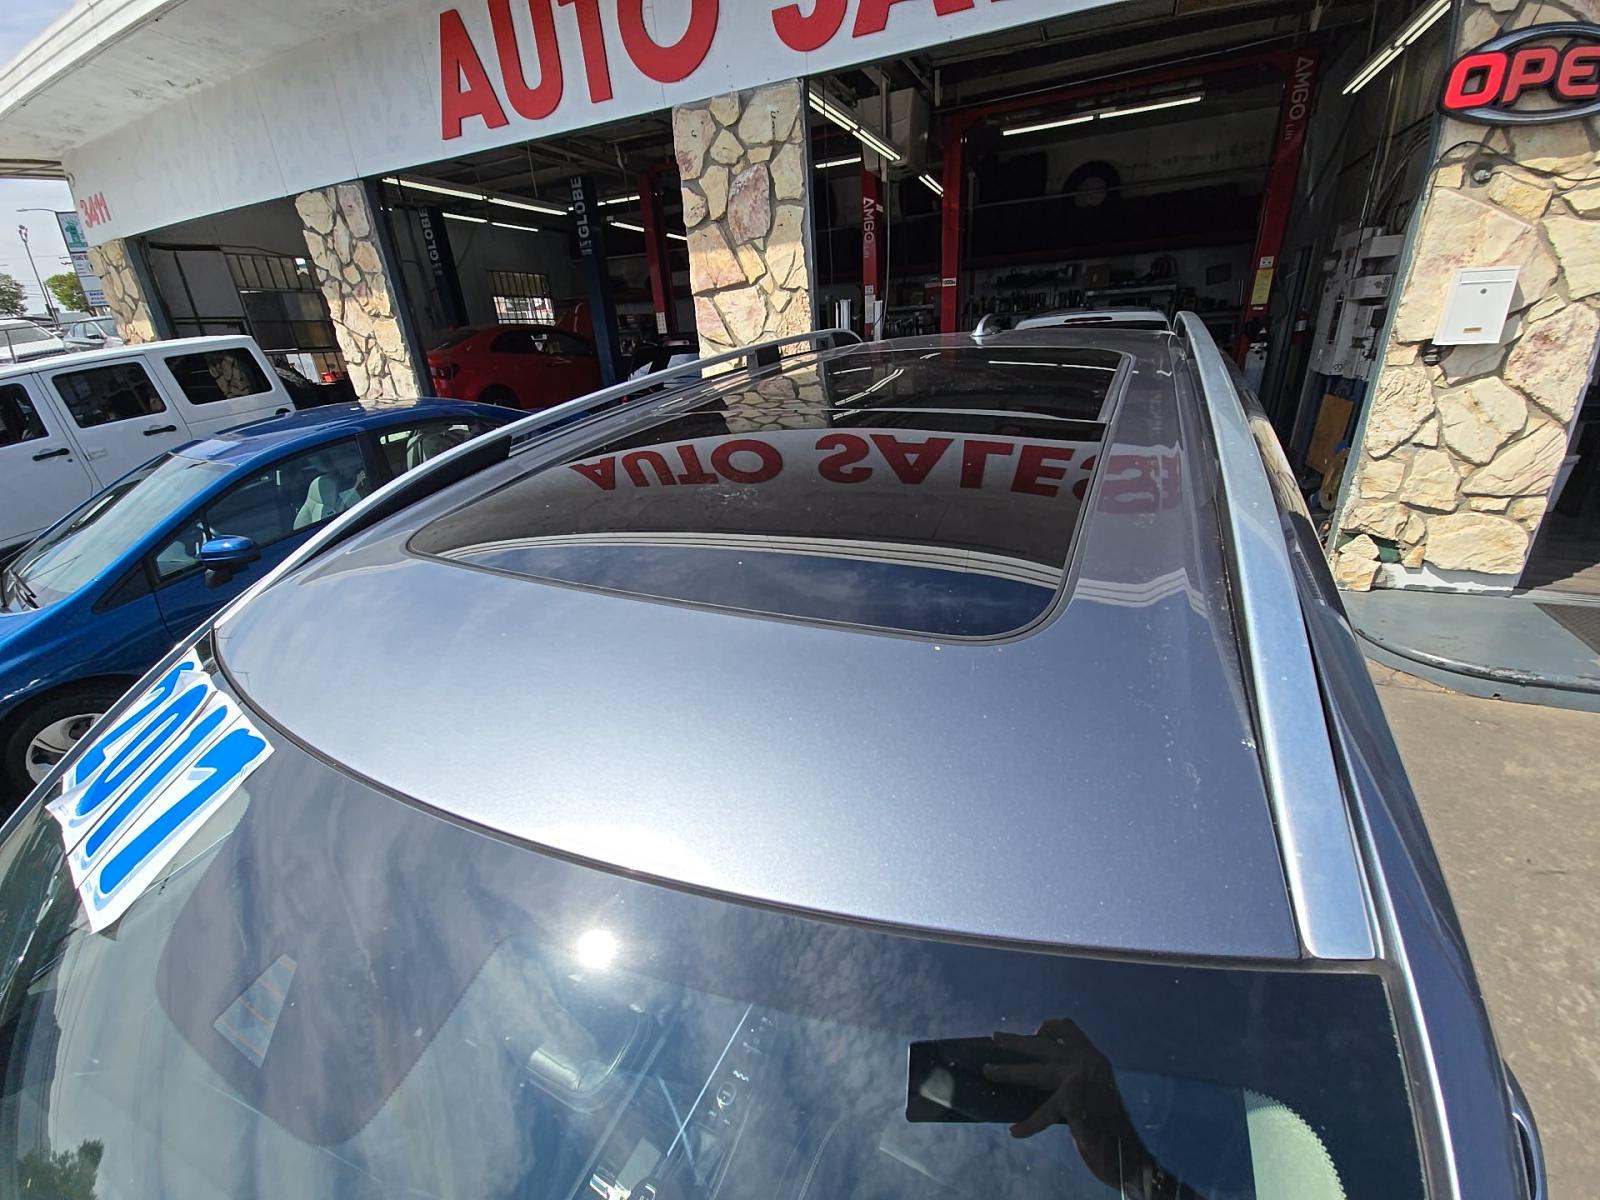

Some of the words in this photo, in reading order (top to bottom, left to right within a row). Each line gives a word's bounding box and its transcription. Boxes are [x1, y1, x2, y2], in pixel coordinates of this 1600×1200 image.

[1289, 56, 1314, 120] AMGO
[419, 207, 440, 261] GLOBE
[570, 176, 590, 238] GLOBE
[863, 197, 875, 243] AMGO
[75, 661, 267, 895] 2017
